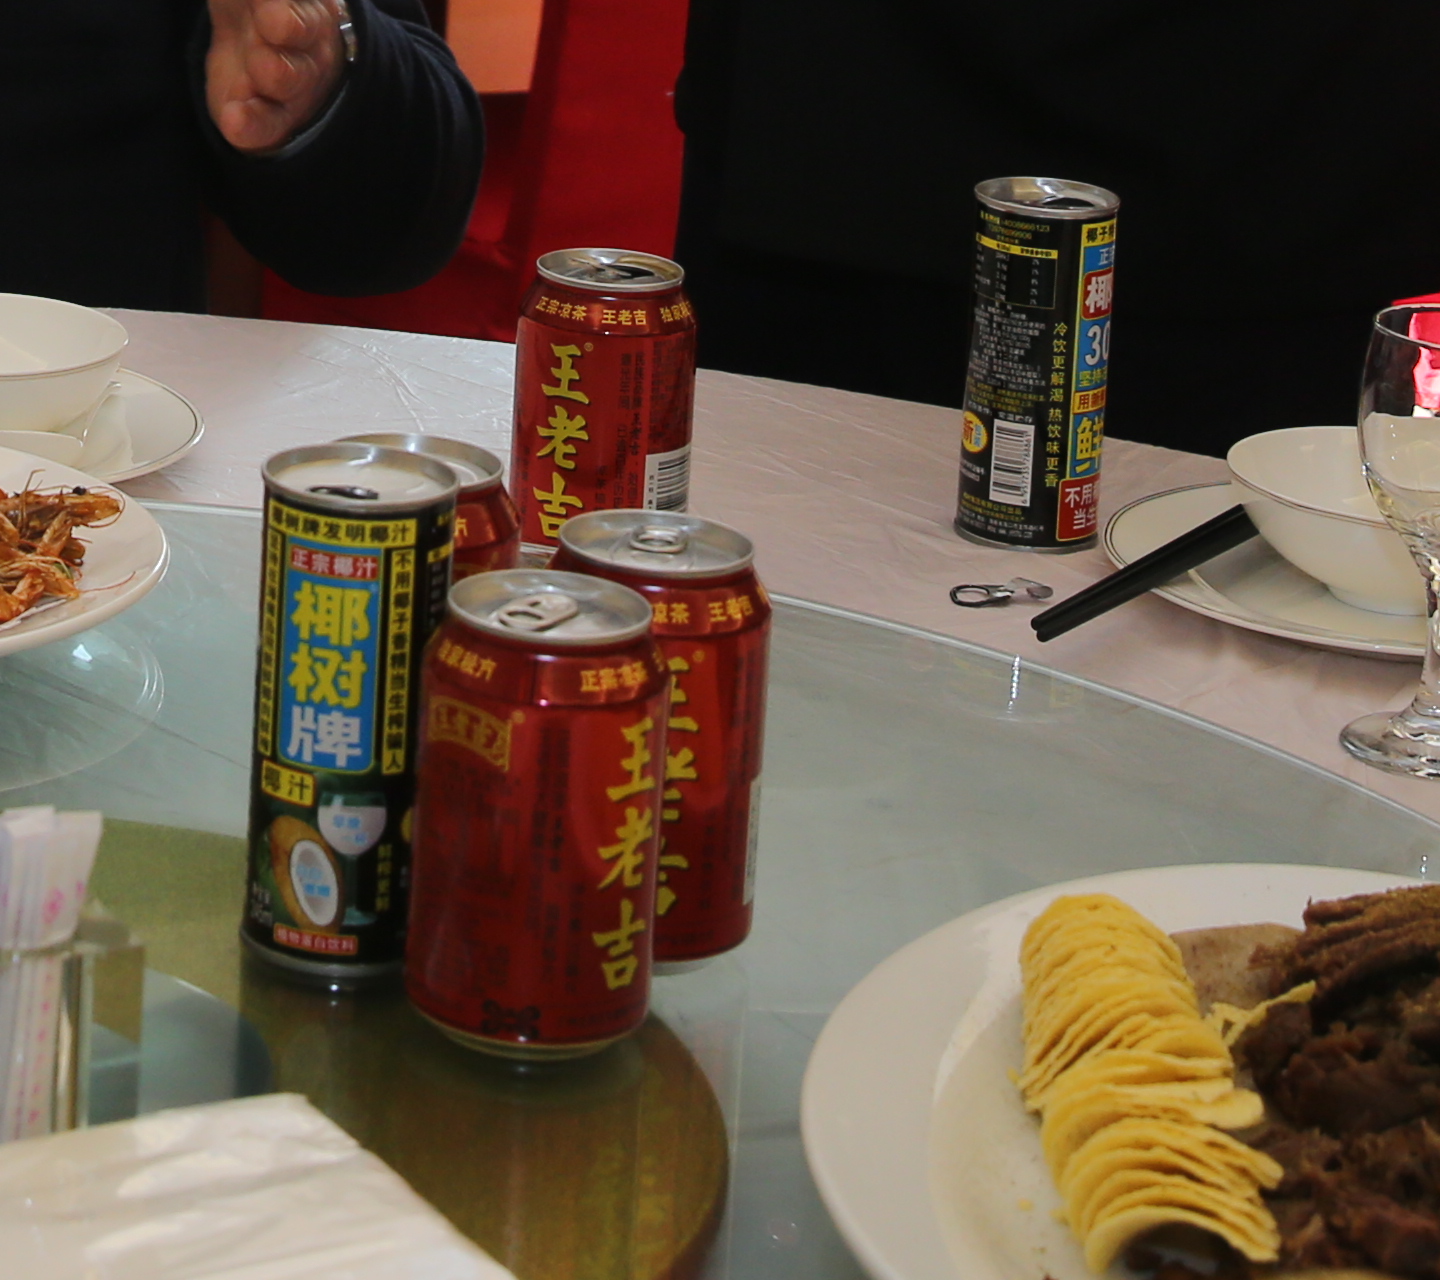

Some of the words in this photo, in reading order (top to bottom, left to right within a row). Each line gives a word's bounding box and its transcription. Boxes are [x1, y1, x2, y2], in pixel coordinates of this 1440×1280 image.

[601, 308, 648, 327] 王老吉
[1049, 322, 1068, 403] 冷饮更解渴
[532, 343, 590, 540] 王老吉
[1044, 406, 1063, 489] 热饮味更香
[291, 546, 377, 578] 正宗椰汁
[287, 580, 372, 768] 椰树牌
[591, 716, 657, 990] 王老吉
